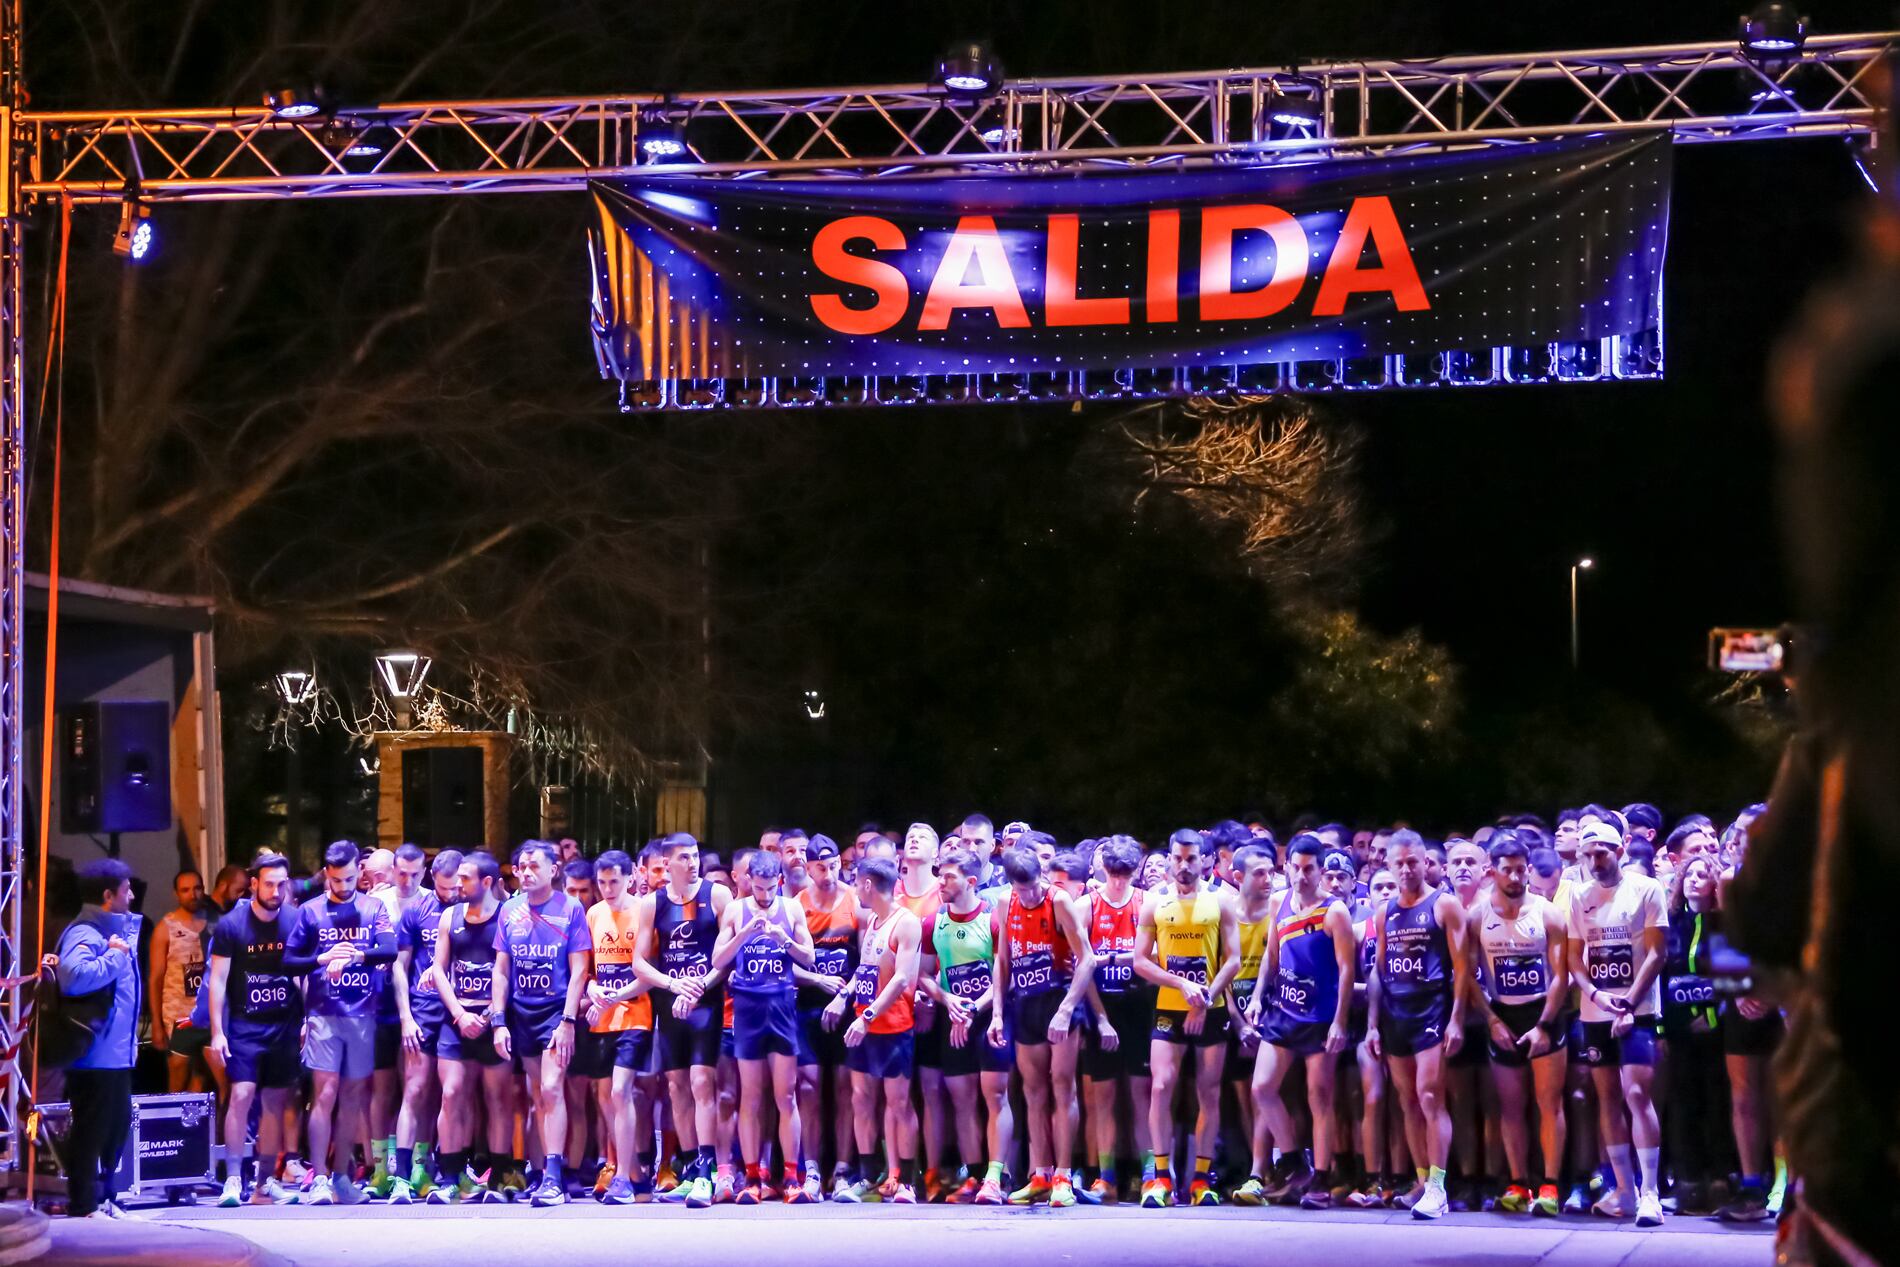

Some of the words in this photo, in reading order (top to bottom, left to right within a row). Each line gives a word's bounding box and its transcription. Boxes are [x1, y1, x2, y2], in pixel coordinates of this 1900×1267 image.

[810, 195, 1431, 335] SALIDA
[319, 927, 370, 941] saxun
[511, 943, 561, 957] saxun
[668, 963, 708, 980] 0460
[747, 959, 784, 973] 0718
[1103, 966, 1132, 980] 1119
[1388, 958, 1423, 973] 1604
[1590, 962, 1632, 979] 0960
[331, 972, 369, 986] 0020
[458, 976, 491, 991] 1097
[518, 974, 551, 988] 0170
[1017, 966, 1052, 988] 0257
[1500, 970, 1540, 987] 1549
[951, 975, 992, 995] 0633
[251, 987, 287, 1003] 0316
[1280, 984, 1306, 1004] 1162
[1674, 986, 1713, 1003] 0132
[150, 1139, 184, 1149] MARK
